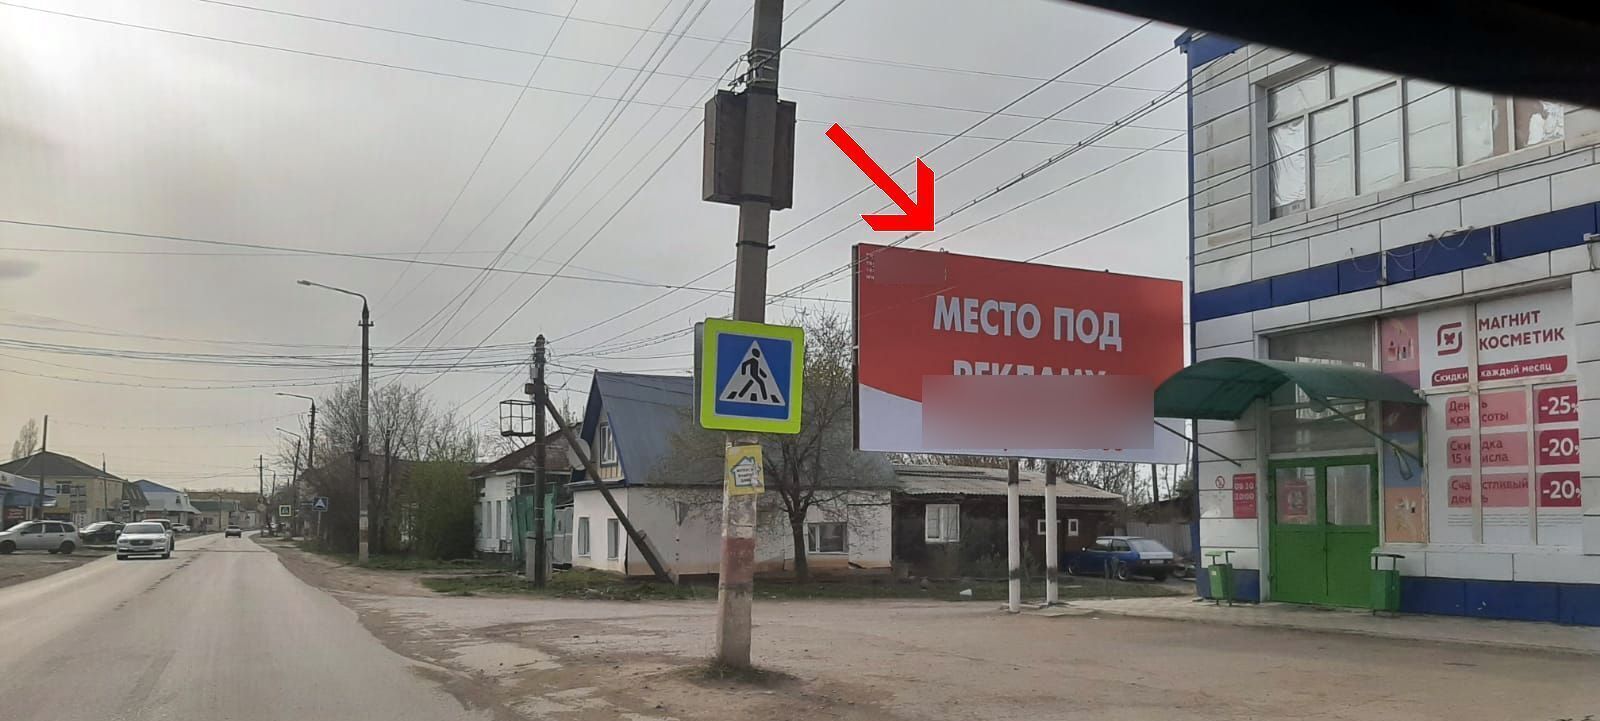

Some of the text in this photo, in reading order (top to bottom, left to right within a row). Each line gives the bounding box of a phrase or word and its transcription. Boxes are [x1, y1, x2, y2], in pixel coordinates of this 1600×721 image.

[933, 295, 1122, 352] МЕСТО ПОД
[1479, 310, 1541, 331] МАГНИТ
[1479, 327, 1565, 350] КОСМЕТИК
[1434, 363, 1553, 384] Скидки каждый месяц
[1451, 454, 1462, 464] 15
